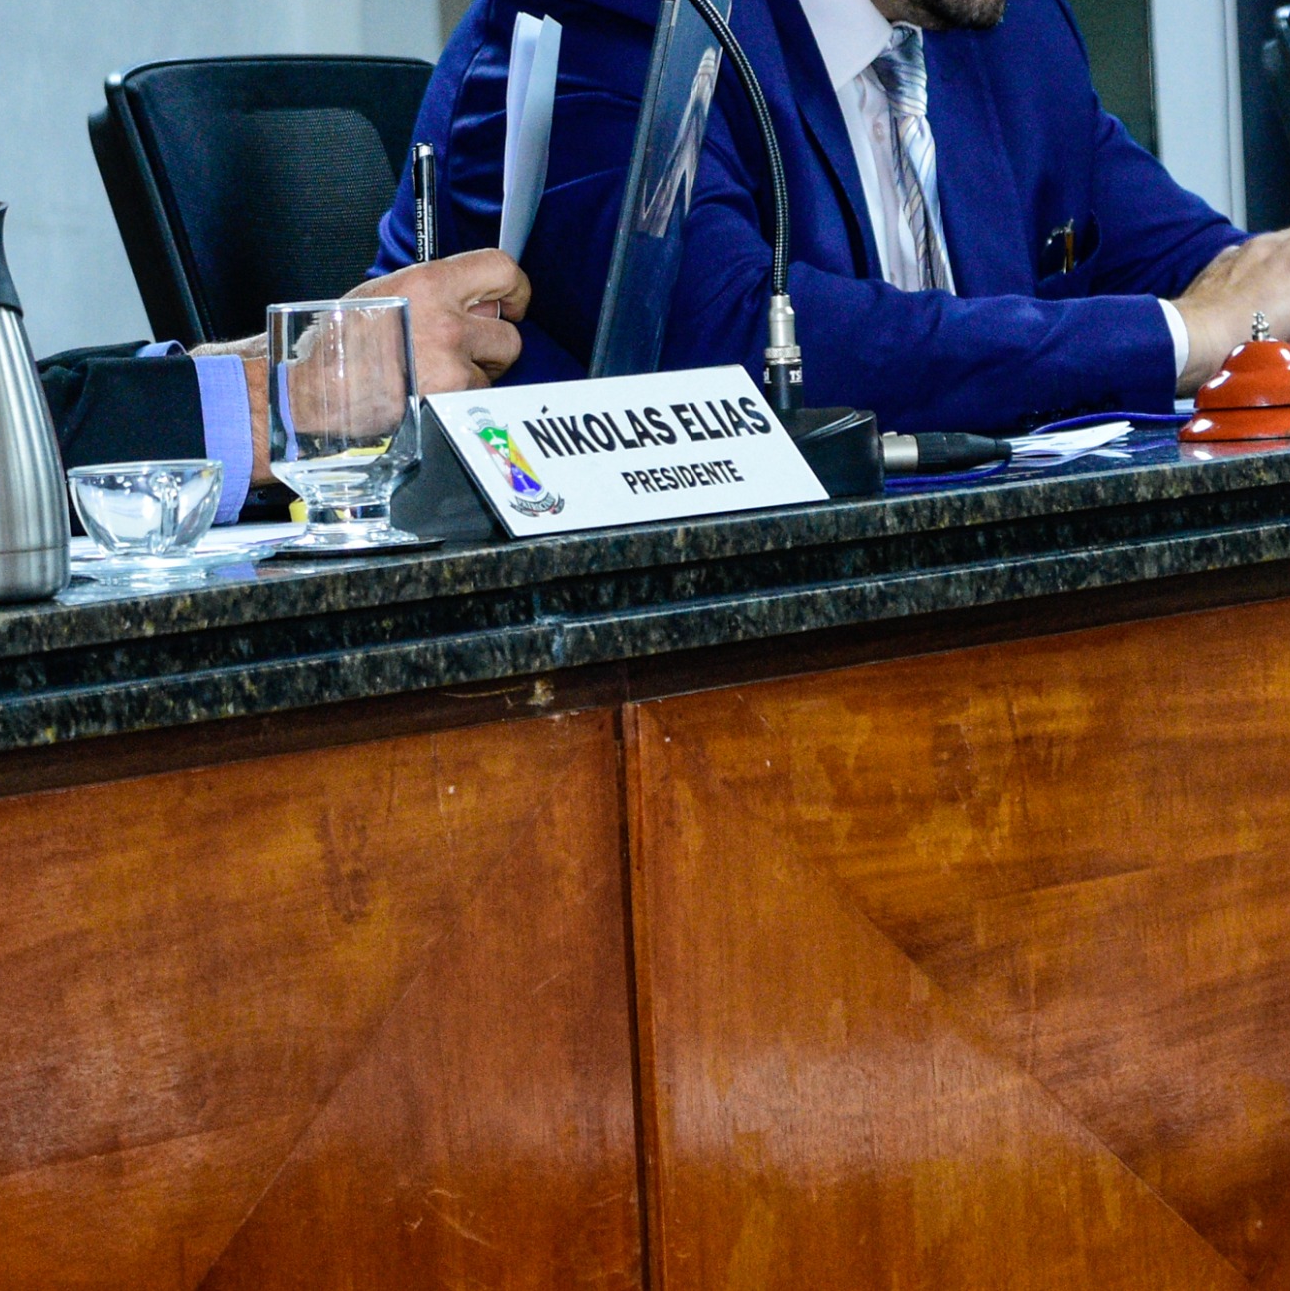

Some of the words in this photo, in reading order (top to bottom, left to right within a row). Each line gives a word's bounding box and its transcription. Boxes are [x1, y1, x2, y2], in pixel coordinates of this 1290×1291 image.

[522, 405, 678, 459] NÍKOLAS
[669, 396, 772, 442] ELIAS
[621, 459, 745, 495] PRESIDENTE
